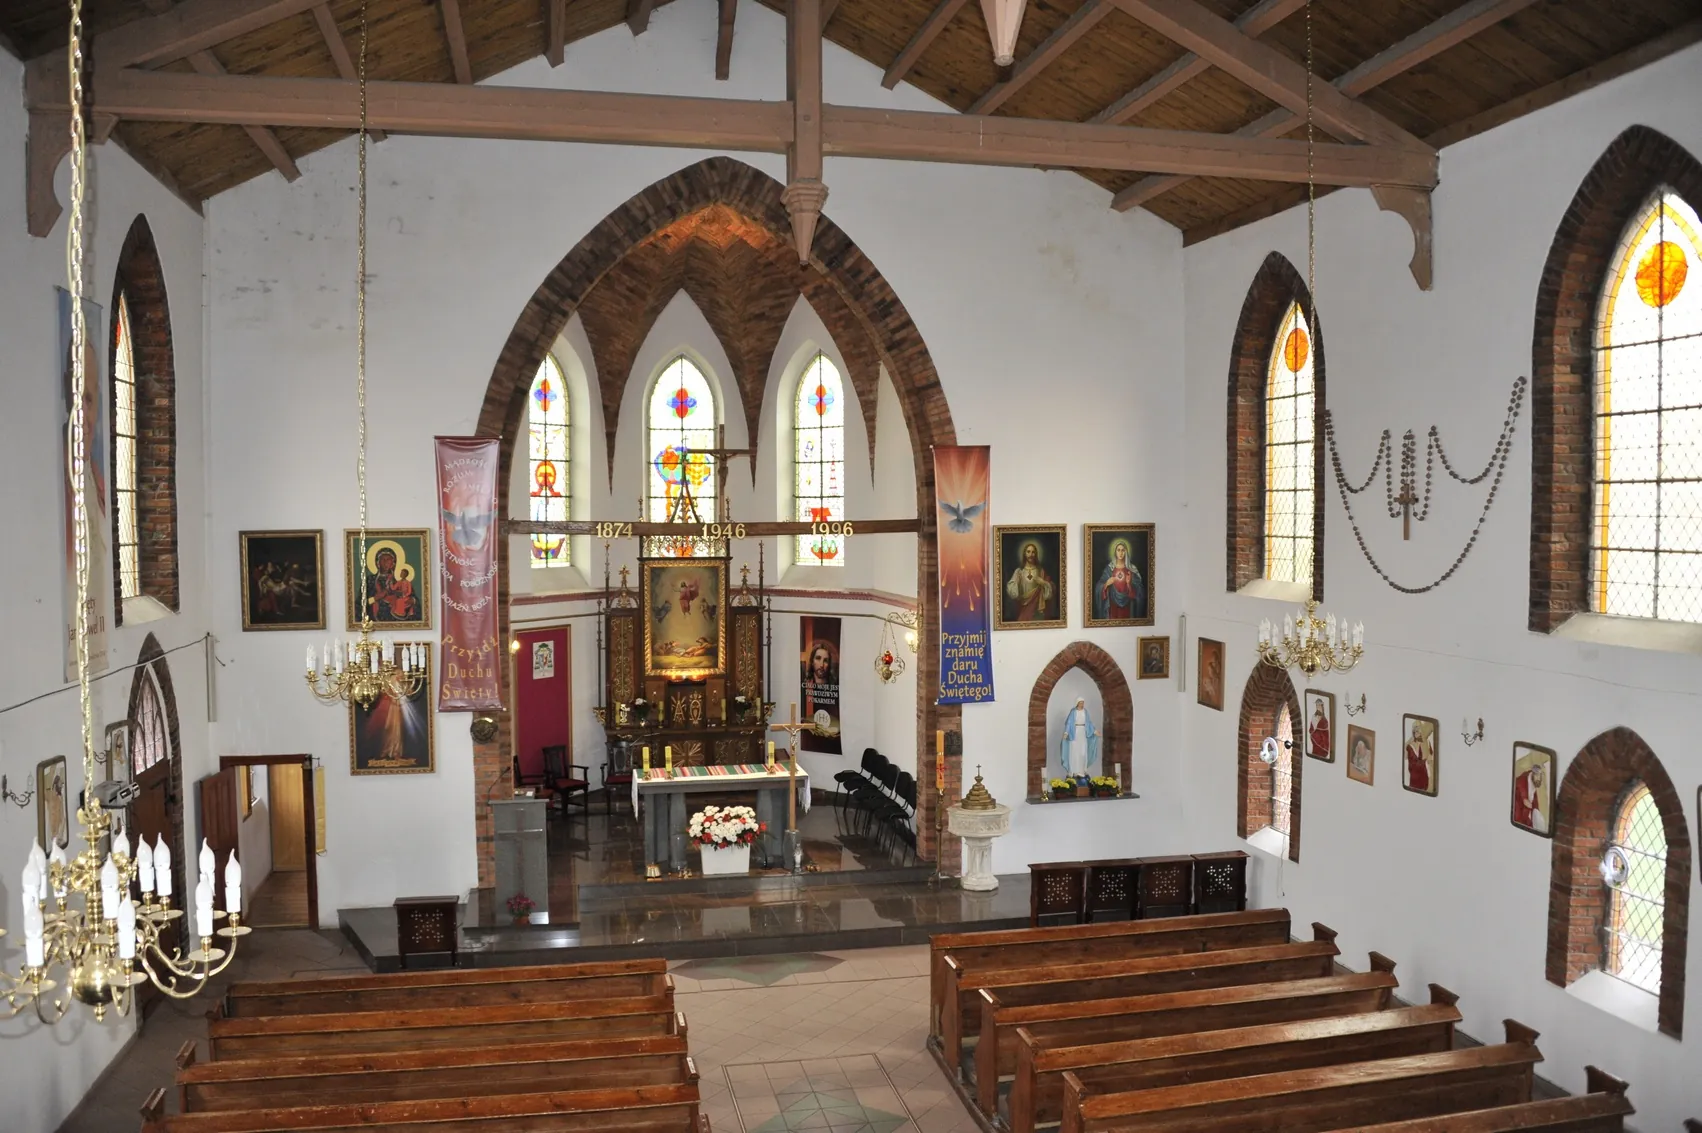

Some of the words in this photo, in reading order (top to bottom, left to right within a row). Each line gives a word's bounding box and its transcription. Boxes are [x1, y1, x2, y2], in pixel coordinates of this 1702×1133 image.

[596, 523, 632, 539] 1874
[702, 523, 746, 540] 1946
[811, 522, 854, 538] 1996
[942, 630, 987, 648] Przyjmij
[441, 633, 498, 664] Przyjdź
[945, 644, 984, 659] znamię
[448, 662, 492, 679] Duchu
[952, 658, 978, 671] daru
[948, 670, 983, 685] Ducha
[442, 680, 498, 702] Święty!
[940, 681, 992, 701] Świętego!
